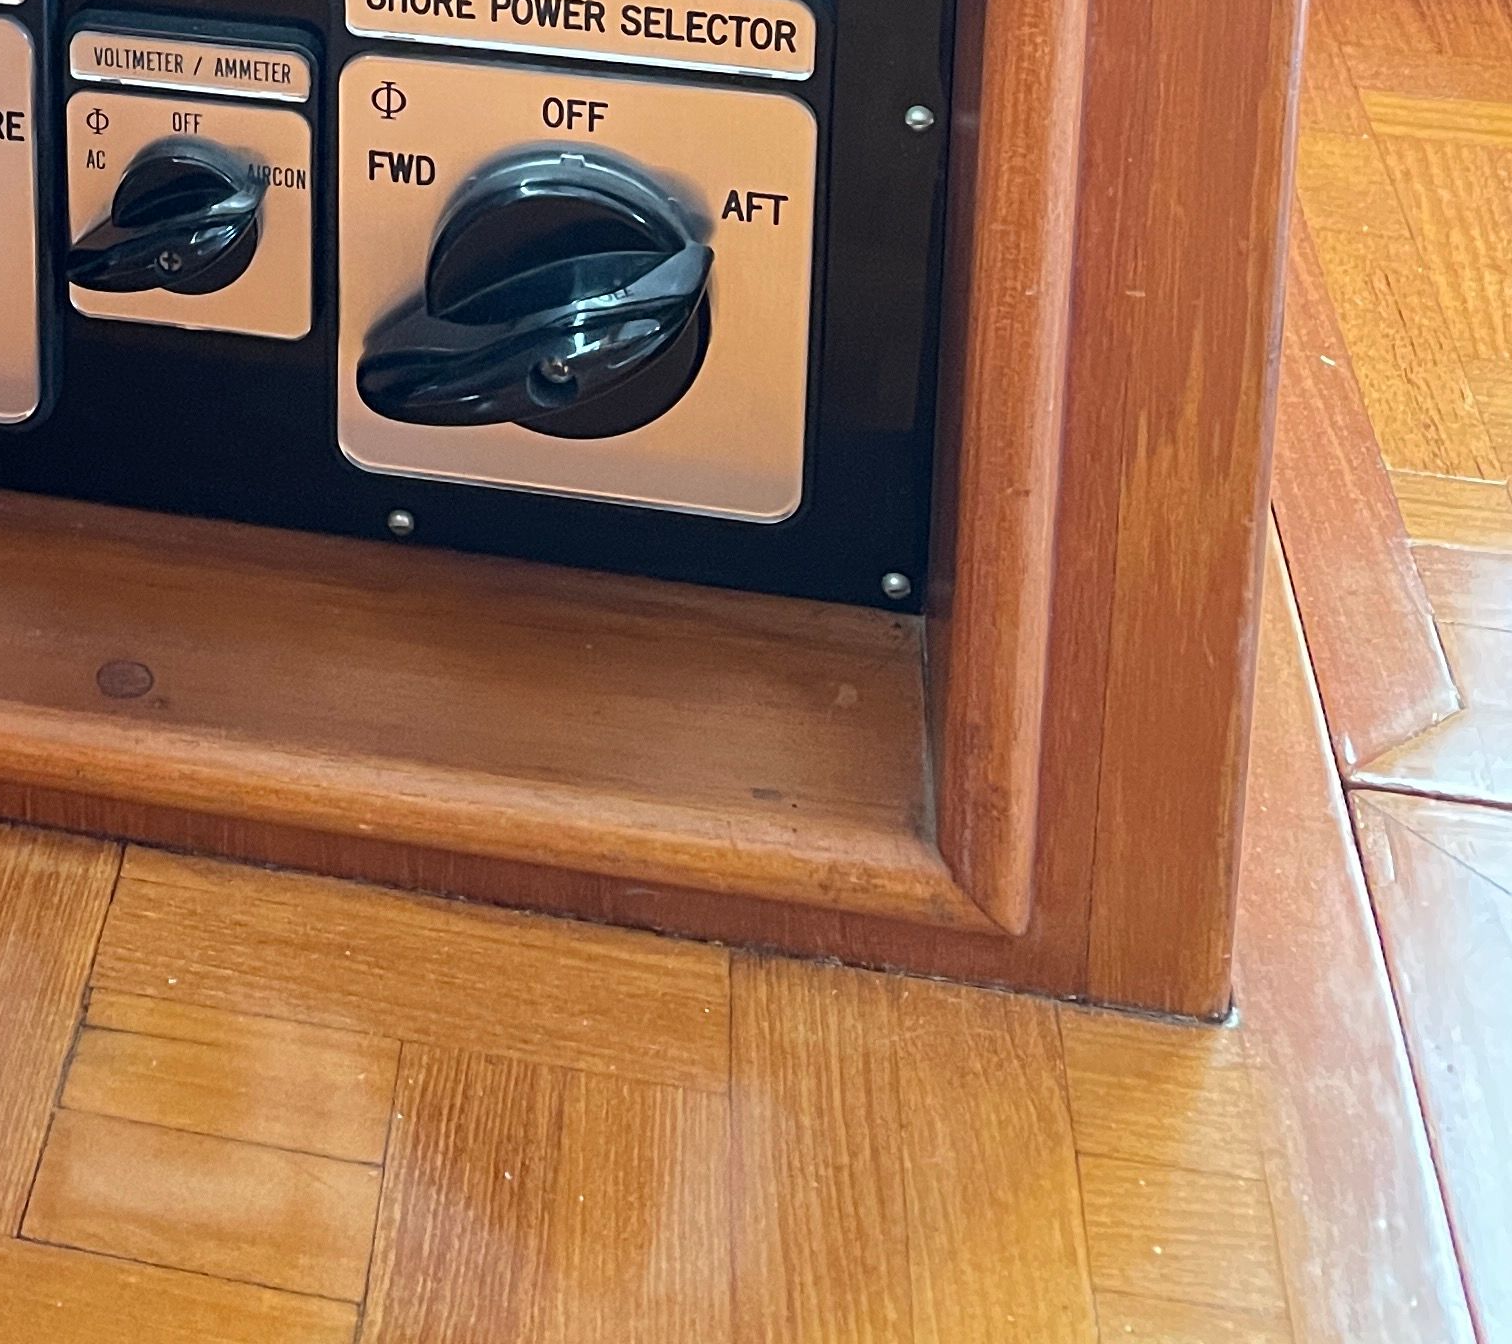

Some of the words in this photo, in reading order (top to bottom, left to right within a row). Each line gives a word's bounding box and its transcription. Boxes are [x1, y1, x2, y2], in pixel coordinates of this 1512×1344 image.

[620, 5, 797, 53] SELECTOR
[93, 47, 184, 74] VOLTMETER
[214, 58, 291, 84] AMMETER
[172, 112, 203, 134] OFF
[542, 96, 608, 132] OFF
[86, 149, 106, 170] AC
[246, 163, 306, 189] AIRCON
[368, 149, 436, 186] FWD
[721, 190, 788, 226] AFT
